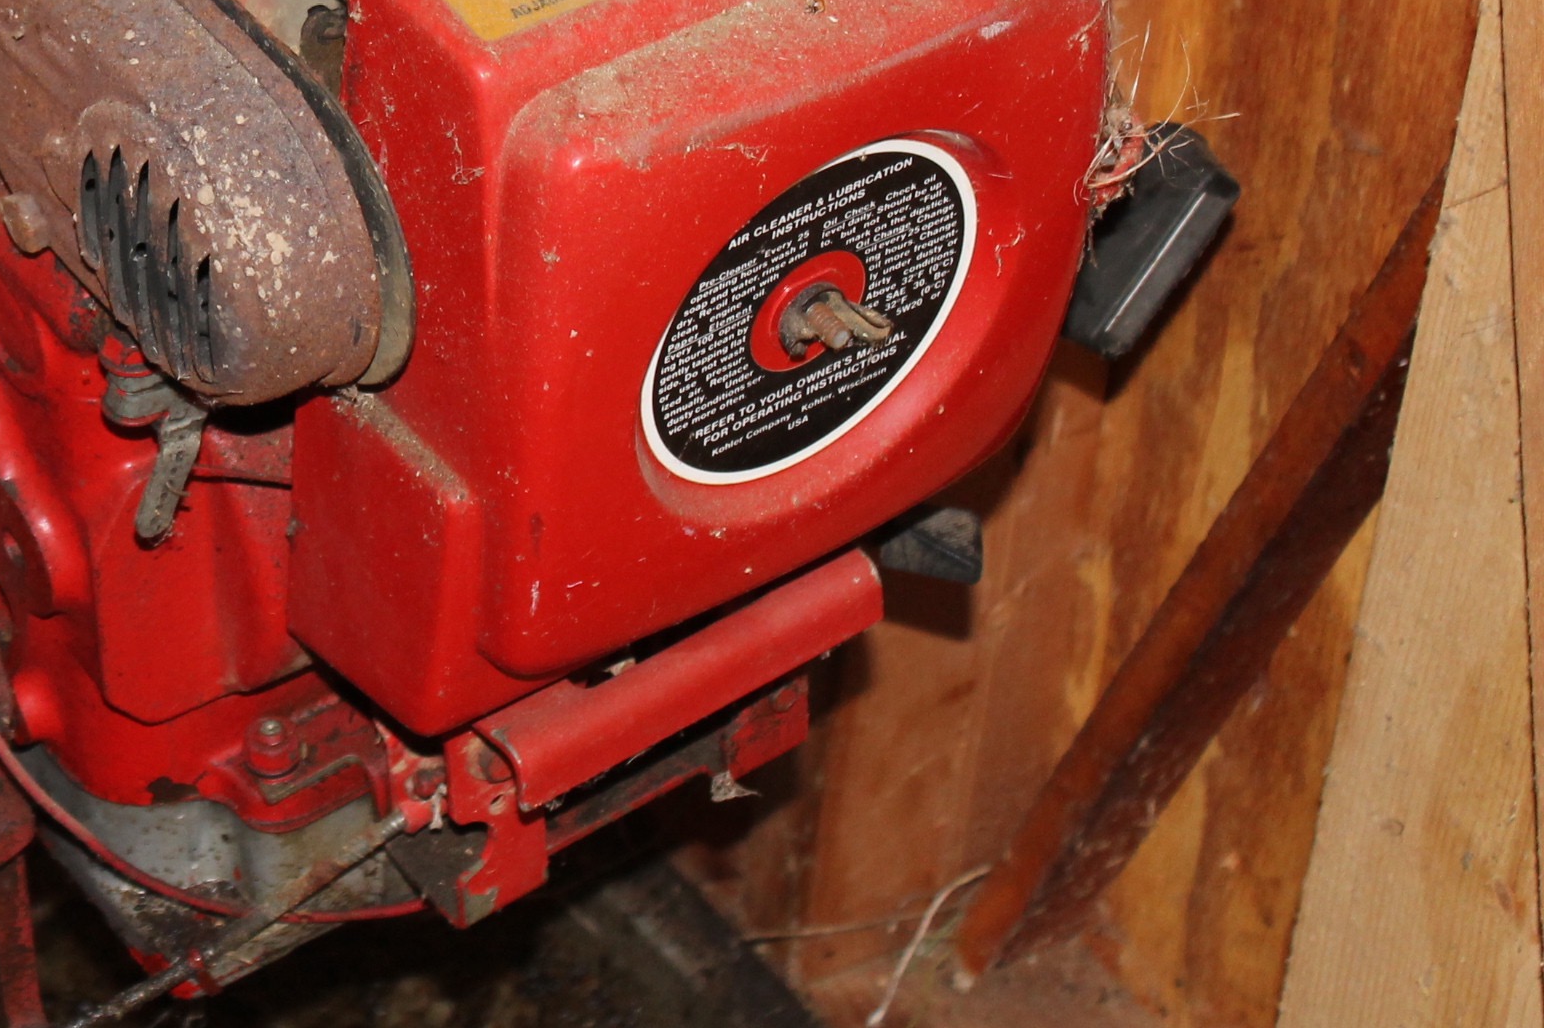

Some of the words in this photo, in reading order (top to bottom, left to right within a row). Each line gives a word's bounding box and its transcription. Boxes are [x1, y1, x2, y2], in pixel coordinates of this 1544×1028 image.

[728, 232, 750, 250] AIR
[753, 202, 812, 237] CLEANER
[816, 197, 824, 208] &
[828, 157, 913, 202] LUBRICATION
[772, 189, 866, 240] INSTRUCTIONS
[822, 223, 845, 238] level
[848, 212, 874, 227] daily.
[876, 193, 912, 214] Should
[914, 188, 928, 198] be
[930, 182, 942, 192] up
[823, 216, 838, 230] Oil
[844, 200, 876, 220] Check
[885, 183, 916, 201] Check
[924, 174, 936, 185] oil
[840, 226, 856, 239] but
[864, 216, 880, 228] not
[846, 230, 871, 246] mark
[874, 223, 887, 233] on
[890, 215, 906, 226] the
[856, 238, 870, 250] Oil
[873, 222, 912, 242] Change
[916, 204, 955, 224] Change
[864, 244, 878, 254] oil
[878, 234, 906, 249] every
[908, 225, 920, 238] 25
[921, 212, 957, 231] operat-
[866, 252, 881, 264] ing
[920, 220, 957, 240] Change
[868, 261, 882, 272] oil
[884, 250, 911, 265] more
[914, 229, 958, 252] frequent-
[683, 301, 708, 317] soap
[710, 288, 728, 304] and
[762, 261, 786, 277] rinse
[788, 250, 807, 264] and
[690, 277, 738, 304] operating
[740, 261, 768, 279] hours
[771, 247, 796, 263] wash
[799, 241, 808, 250] in
[699, 258, 757, 292] Pre-Cleaner
[764, 240, 792, 258] Every
[798, 230, 810, 242] 25
[868, 276, 892, 291] dirty
[869, 272, 878, 281] ly
[882, 258, 912, 275] under
[916, 244, 943, 261] dusty
[947, 238, 958, 247] or
[676, 317, 695, 330] dry.
[699, 298, 728, 318] Re-oil
[732, 286, 756, 302] foam
[760, 273, 780, 287] with
[865, 282, 897, 302] Above
[886, 286, 906, 302] SAE
[934, 270, 950, 281] Be-
[896, 298, 923, 316] 5W20
[930, 292, 940, 300] or
[664, 346, 692, 364] Every
[697, 333, 714, 347] 100
[718, 315, 754, 336] operat-
[668, 333, 699, 353] Paper
[708, 304, 752, 332] Element
[671, 324, 698, 342] clean
[709, 302, 742, 322] engine
[658, 380, 682, 395] side.
[684, 370, 698, 382] Do
[701, 360, 717, 374] not
[720, 346, 745, 363] wash
[660, 363, 676, 375] ing
[678, 348, 706, 366] hours
[708, 333, 734, 351] clean
[736, 326, 748, 336] by
[660, 366, 690, 386] gently
[692, 346, 728, 369] tapping
[730, 336, 746, 349] flat
[659, 394, 670, 404] or
[679, 381, 697, 394] use
[706, 356, 746, 382] pressur-
[661, 396, 682, 412] ized
[710, 364, 749, 388] Replace
[664, 394, 706, 420] annually.
[724, 370, 754, 389] Under
[666, 410, 694, 428] dusty
[694, 383, 746, 413] conditions
[746, 374, 766, 388] ser-
[695, 412, 736, 440] REFER
[738, 402, 756, 417] TO
[760, 384, 793, 407] YOUR
[796, 354, 852, 388] OWNER'S
[856, 330, 907, 360] MAUAL
[703, 427, 729, 446] FOR
[732, 391, 802, 431] OPERATING
[806, 345, 897, 395] INSTRUCTIONS
[668, 422, 689, 436] vice
[691, 408, 717, 425] more
[711, 436, 744, 457] Kohler
[746, 413, 792, 440] Company
[838, 366, 887, 394] Wisconsin
[788, 414, 808, 430] USA
